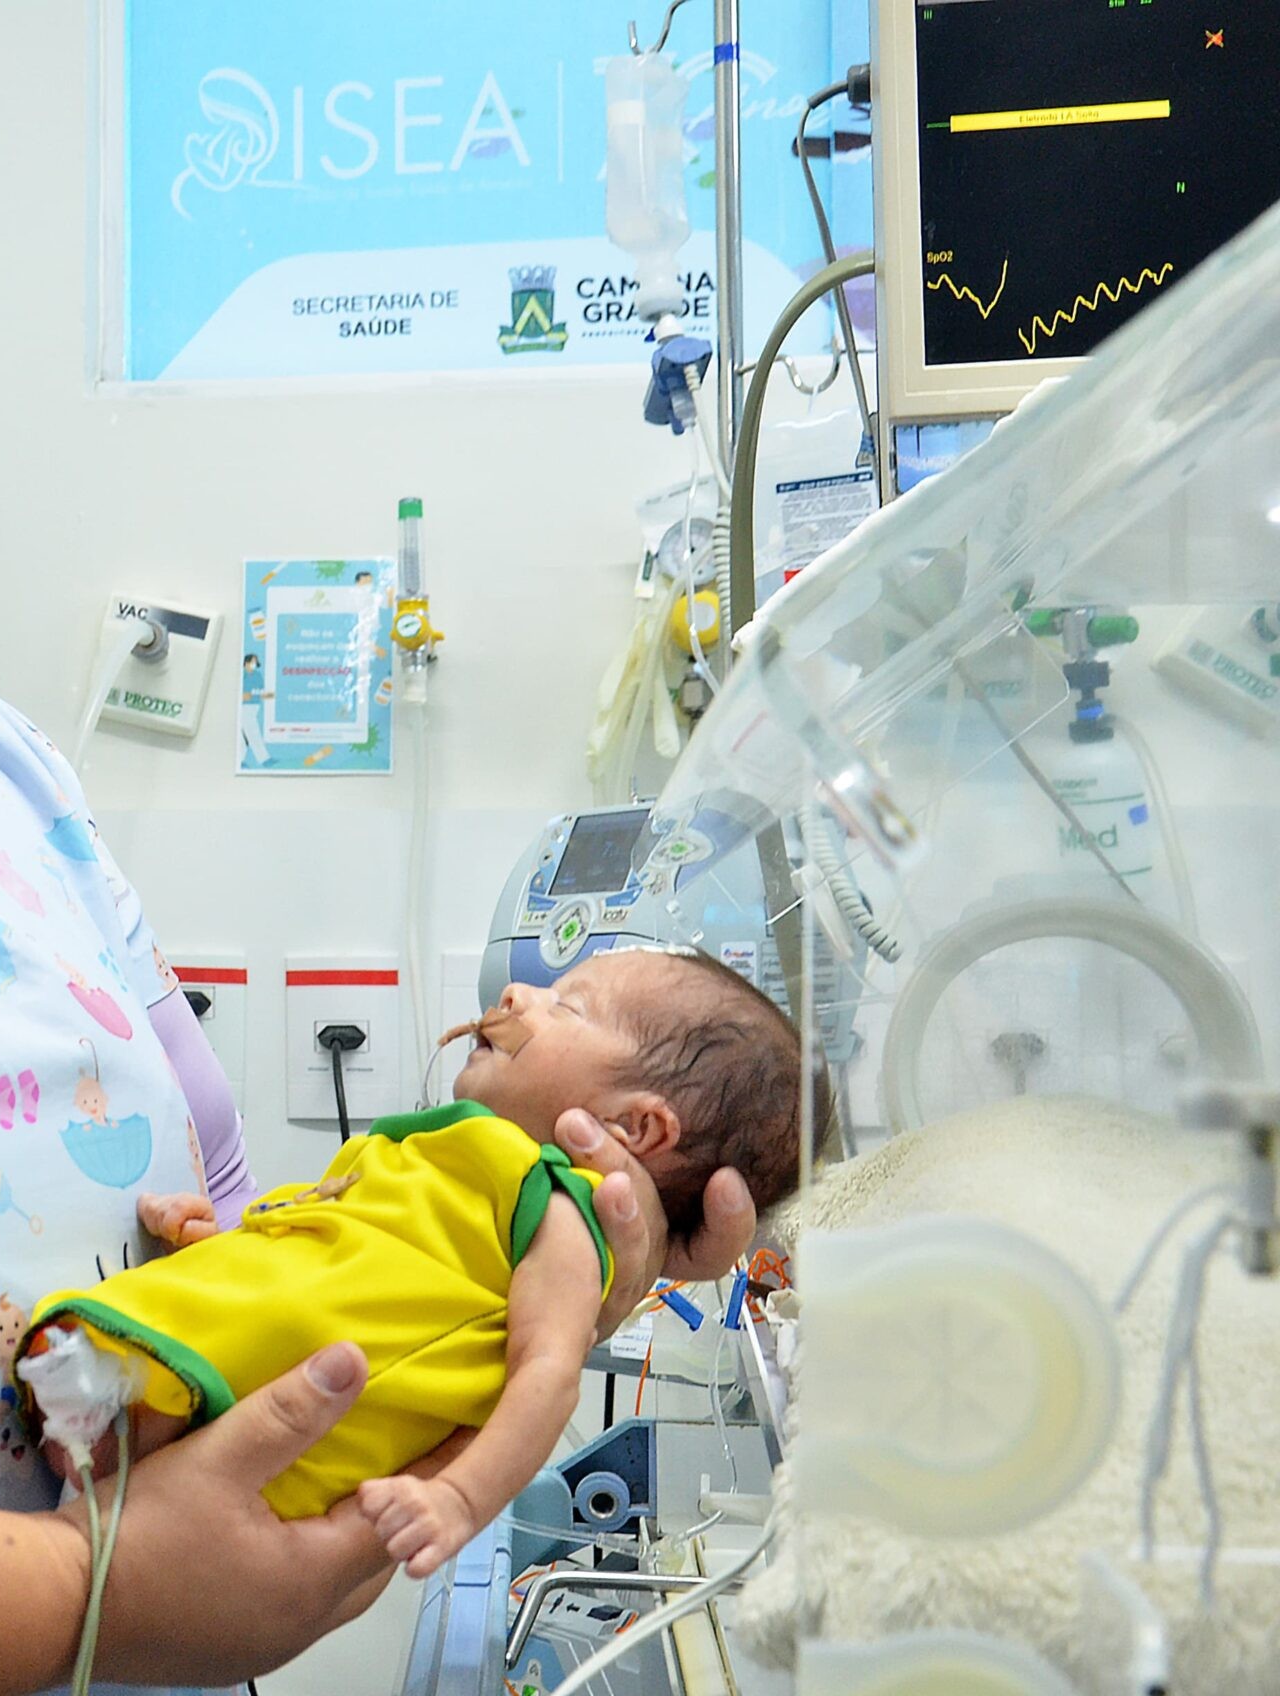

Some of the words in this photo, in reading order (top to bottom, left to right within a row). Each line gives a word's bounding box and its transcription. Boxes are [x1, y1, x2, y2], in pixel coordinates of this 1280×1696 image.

[293, 69, 531, 182] ISEA
[1176, 181, 1186, 194] N
[926, 249, 954, 265] SpO2
[292, 292, 425, 316] SECRETARIA
[430, 290, 459, 309] DE
[339, 316, 412, 338] SAÚDE
[118, 602, 149, 620] VAC
[123, 691, 183, 715] PROTEC
